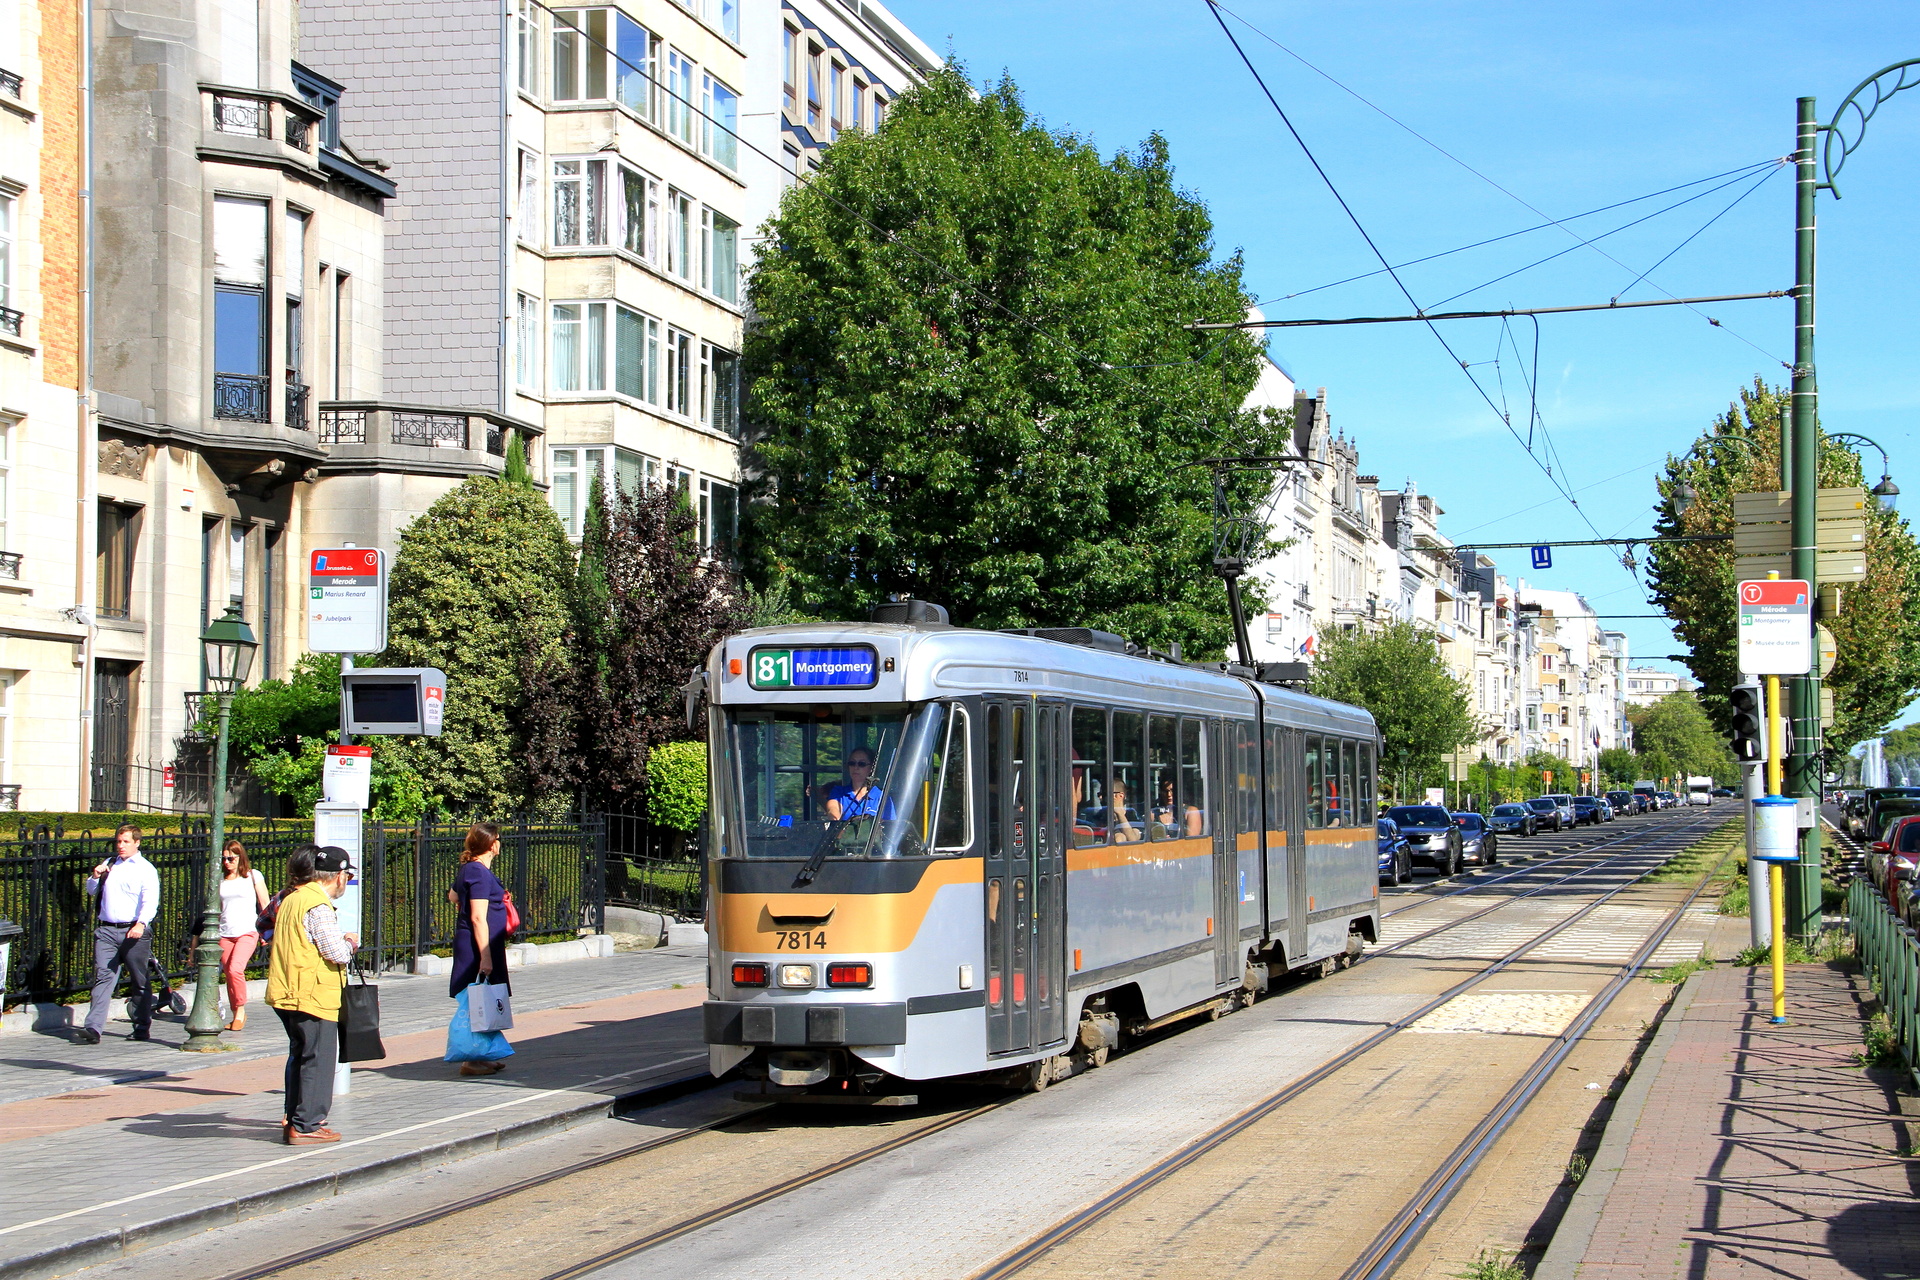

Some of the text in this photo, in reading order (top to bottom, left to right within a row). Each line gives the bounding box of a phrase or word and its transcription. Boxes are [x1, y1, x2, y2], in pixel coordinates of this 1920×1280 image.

[312, 589, 322, 598] 81
[1748, 588, 1756, 598] T
[1742, 616, 1752, 625] 81
[758, 656, 872, 682] 81 Montgomery
[1014, 671, 1028, 682] 7814
[776, 931, 827, 950] 7814
